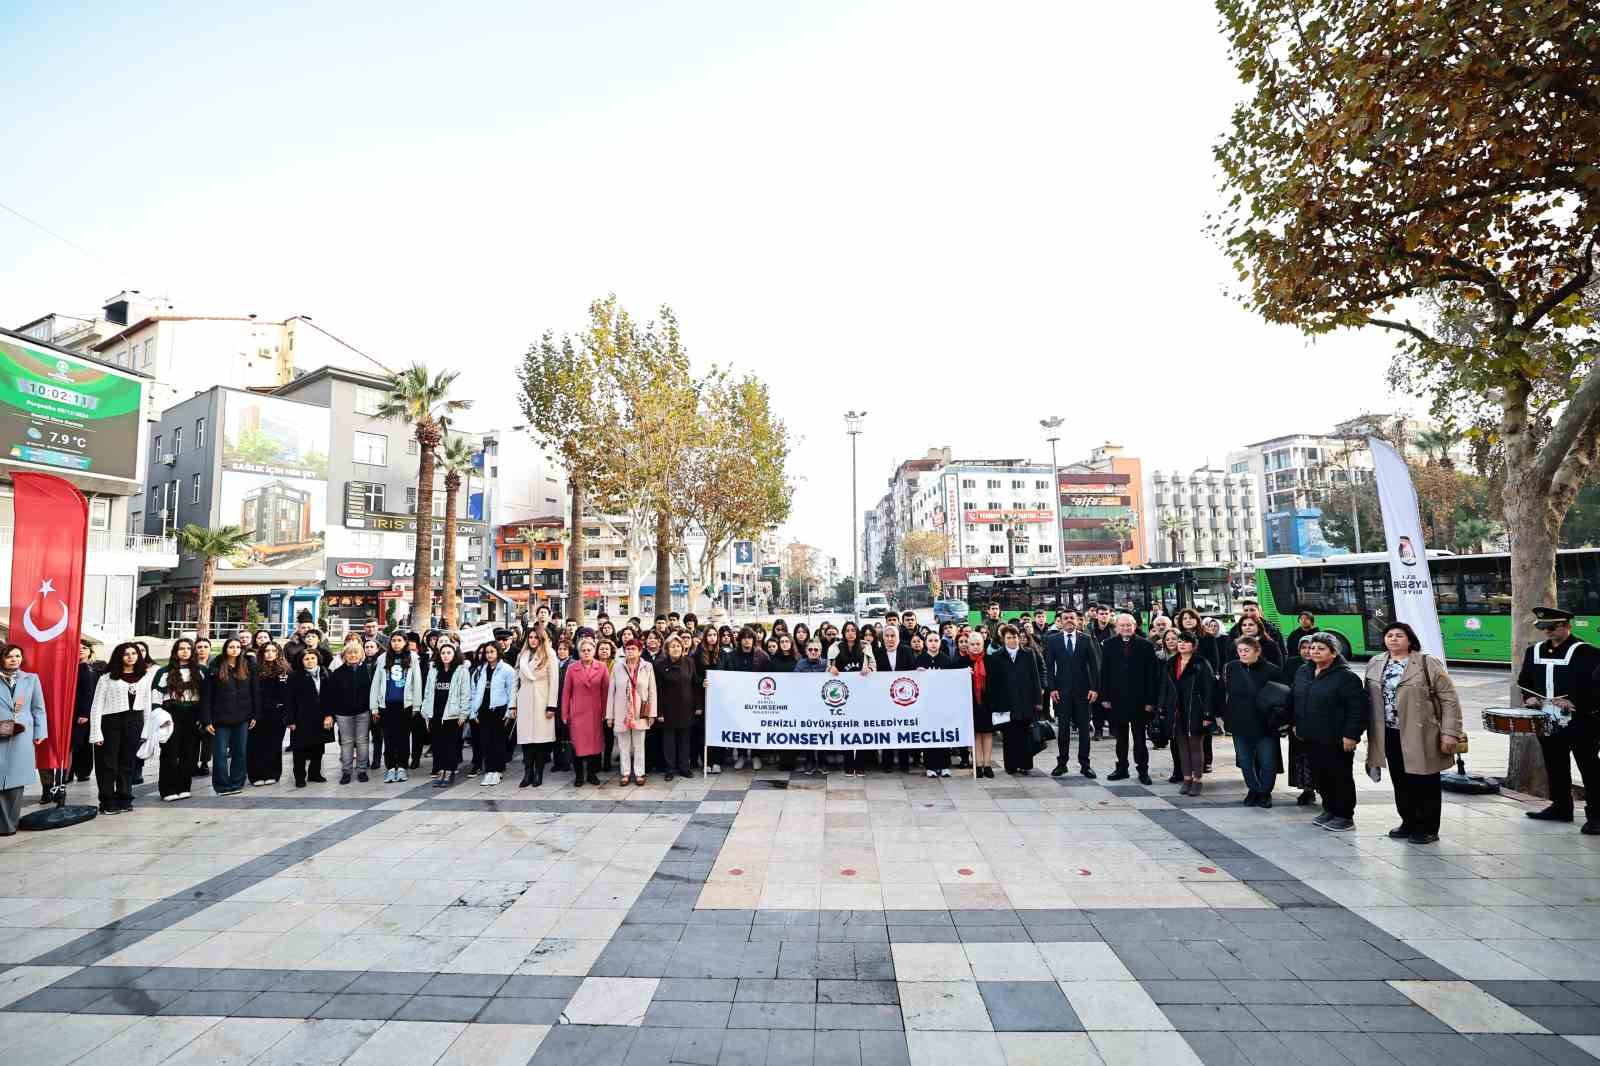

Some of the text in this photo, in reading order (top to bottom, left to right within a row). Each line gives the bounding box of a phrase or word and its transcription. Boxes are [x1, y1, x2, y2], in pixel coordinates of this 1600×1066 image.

[30, 383, 88, 405] 10:02:11
[49, 431, 69, 445] 7.9
[73, 436, 87, 448] °C
[373, 519, 405, 530] IRIS
[391, 561, 443, 577] döer
[829, 708, 846, 716] T.C.
[760, 717, 919, 730] DENİZLİ BÜYÜKŞEHİR BELEDİYESİ
[721, 727, 960, 745] KENT KONSEYİ KADIN MECLİSİ
